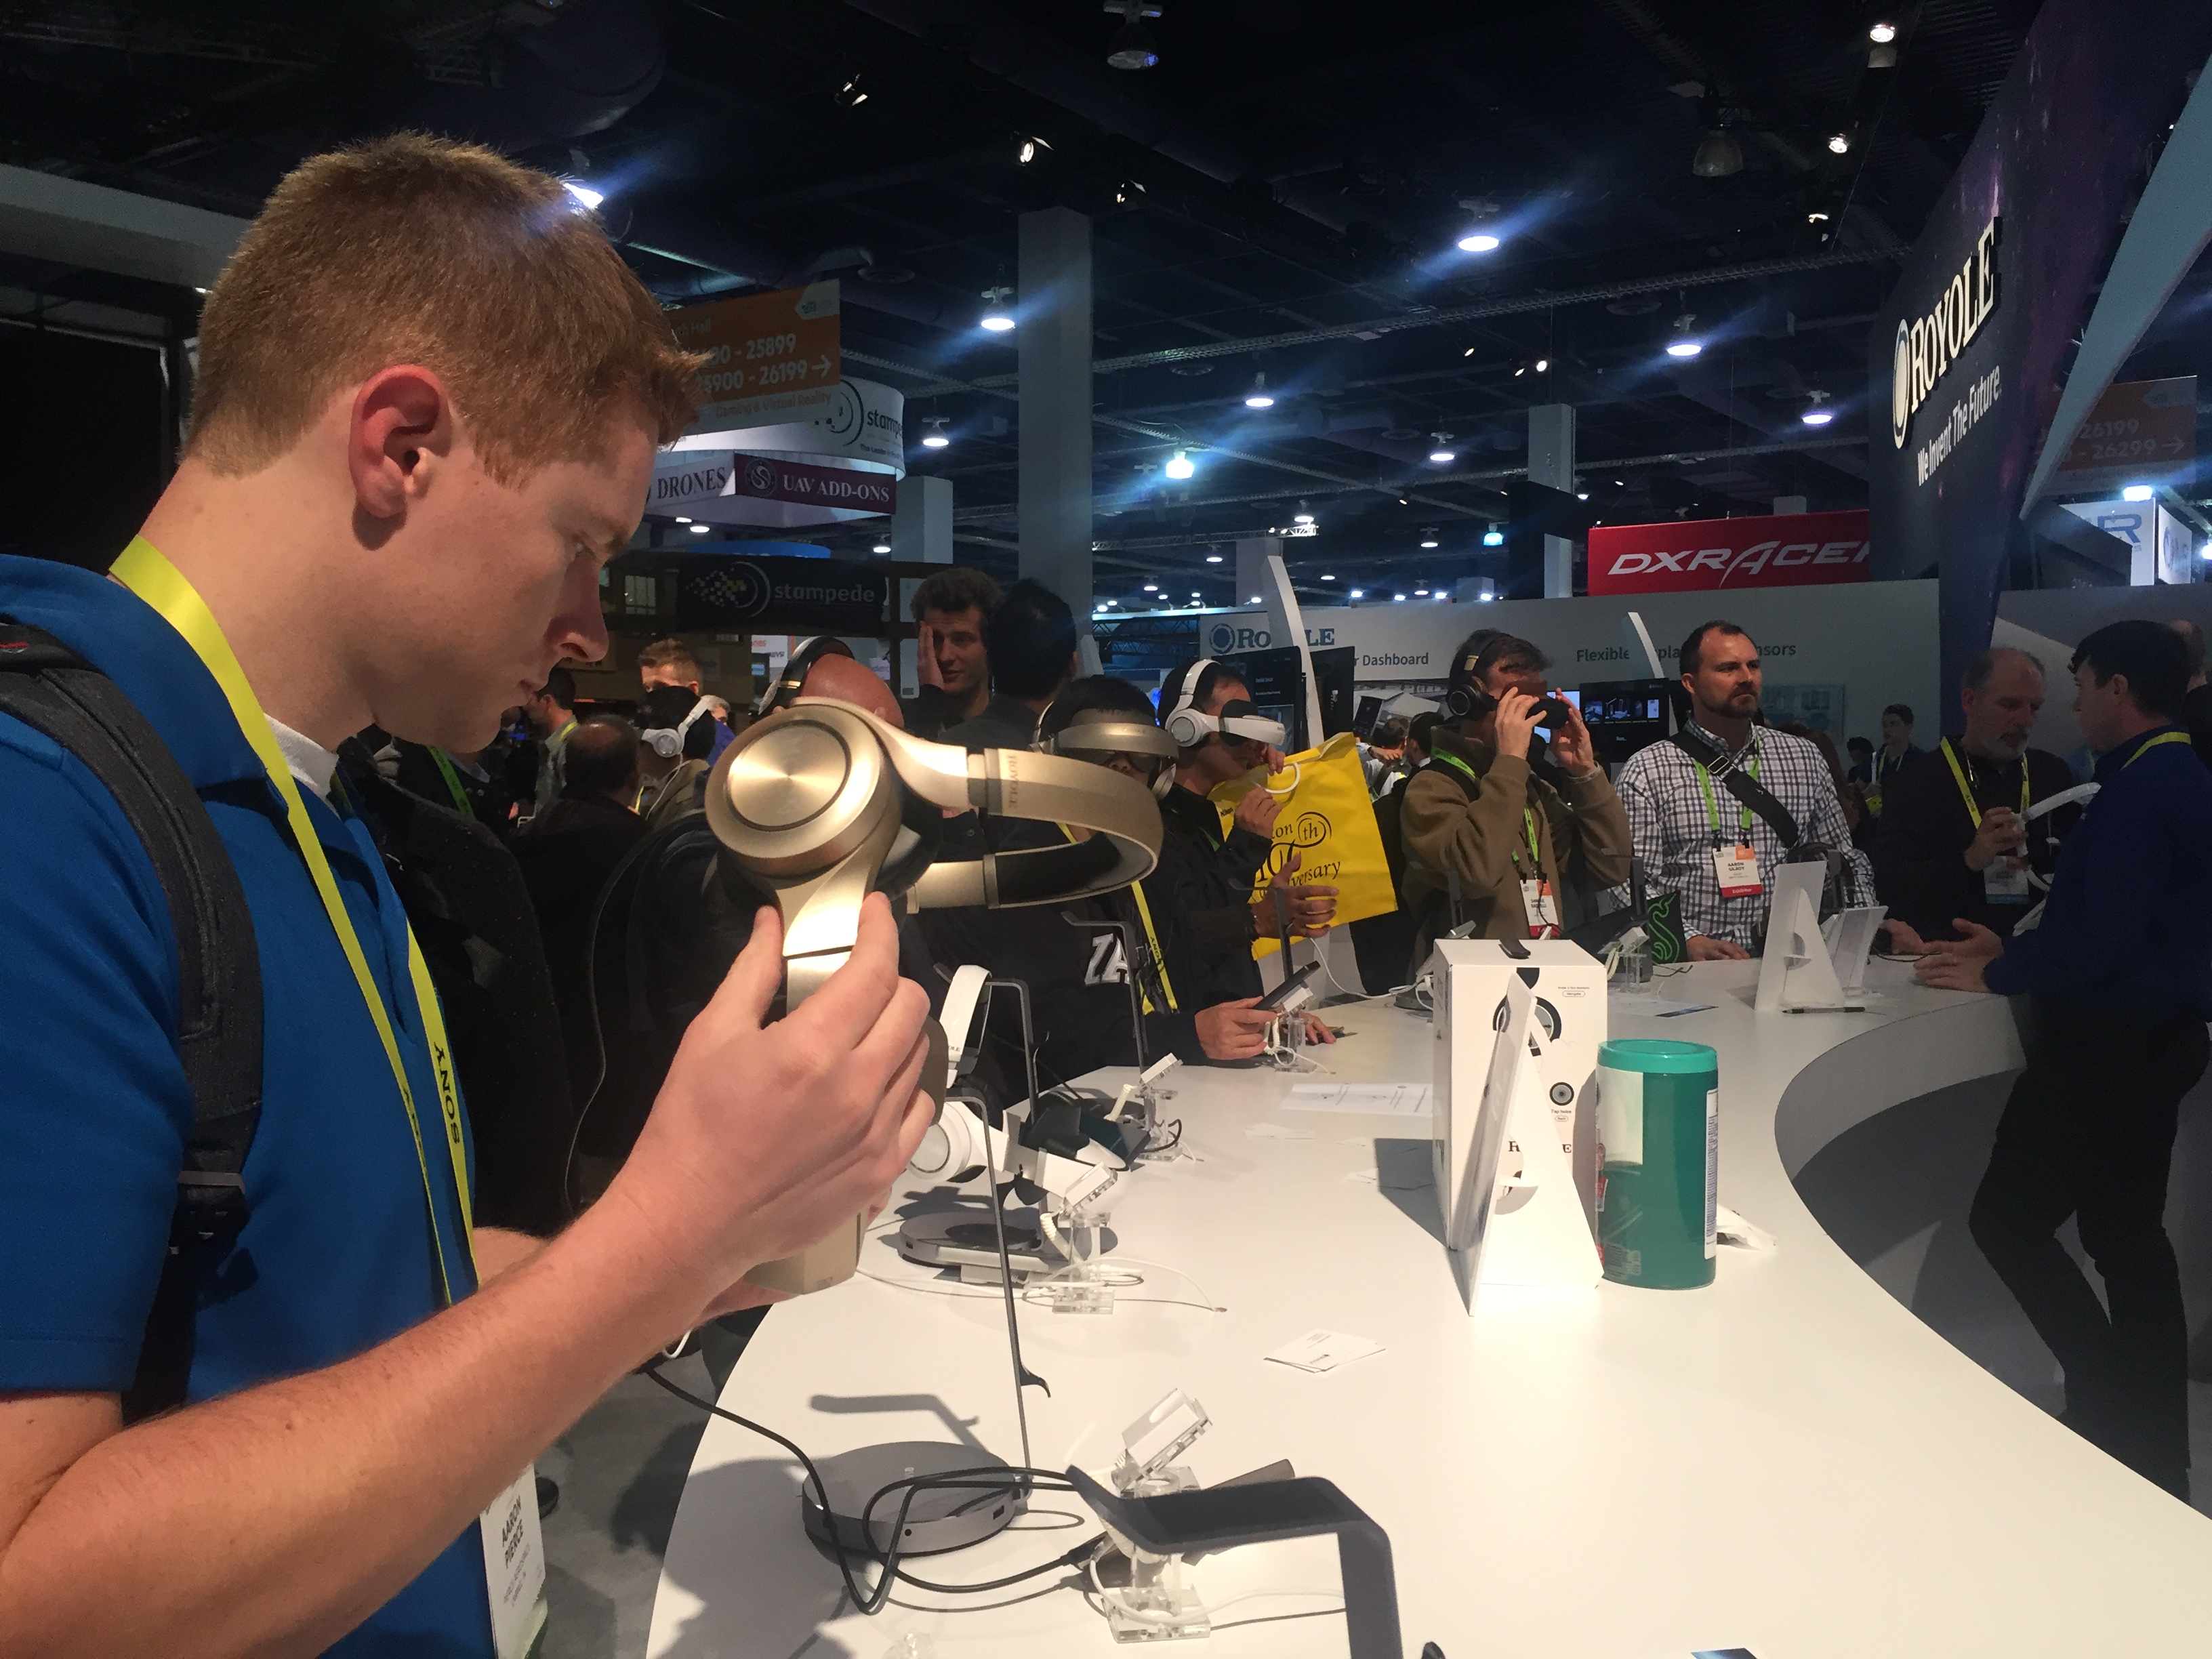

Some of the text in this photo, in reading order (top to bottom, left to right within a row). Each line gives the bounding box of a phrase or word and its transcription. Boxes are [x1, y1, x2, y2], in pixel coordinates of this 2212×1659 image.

[1910, 218, 1994, 414] ROYOLE
[746, 333, 796, 360] 25899
[759, 360, 807, 386] 26199
[716, 403, 752, 418] Gaming
[761, 394, 796, 410] Virtual
[797, 390, 832, 406] Reality
[2081, 419, 2140, 439] 26199
[1918, 447, 1929, 487] We
[1929, 415, 1952, 476] Invent
[1952, 399, 1967, 446] The
[2092, 439, 2156, 459] 26299
[657, 466, 727, 499] DRONES
[783, 474, 890, 502] UAV ADD-ONS
[774, 583, 875, 605] stampede
[1237, 628, 1334, 649] ROLE
[1363, 653, 1429, 666] Dashboard
[1303, 822, 1319, 840] th
[1288, 861, 1340, 886] versary
[433, 1041, 462, 1144] SONY
